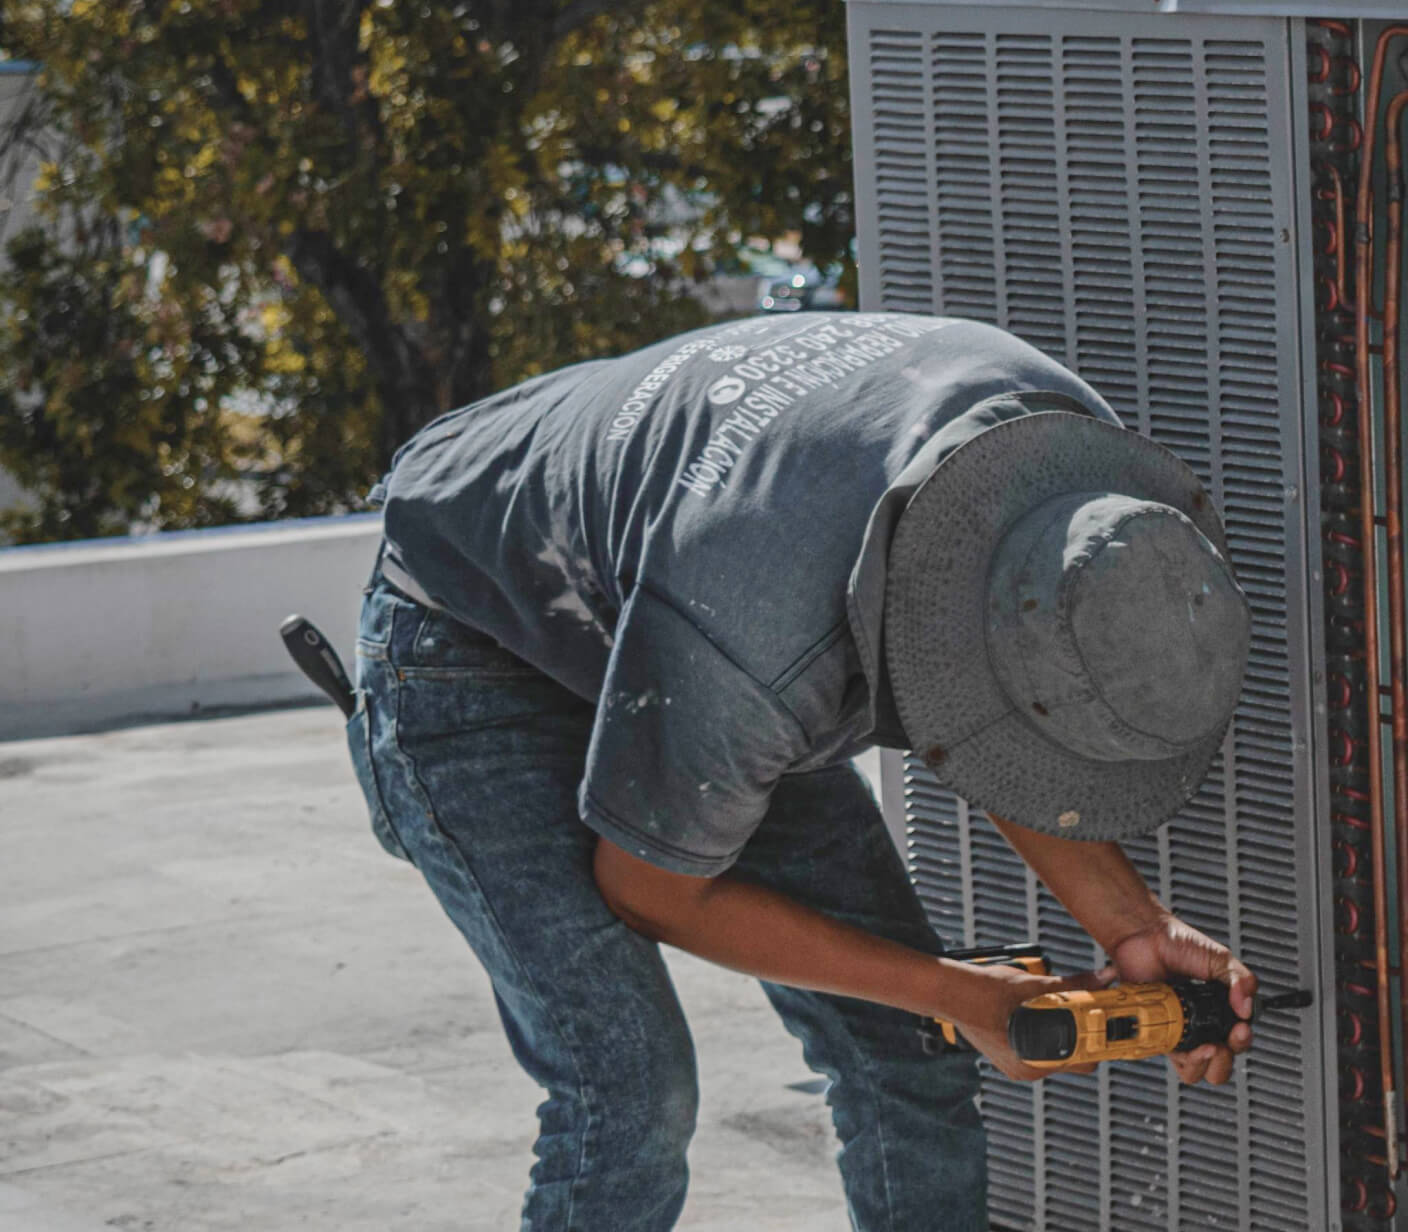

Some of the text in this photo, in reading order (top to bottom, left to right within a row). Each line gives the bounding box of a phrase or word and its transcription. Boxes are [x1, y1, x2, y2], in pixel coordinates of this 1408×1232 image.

[733, 345, 807, 380] 3230
[771, 376, 808, 396] E
[678, 383, 795, 497] INSTALACIÓN
